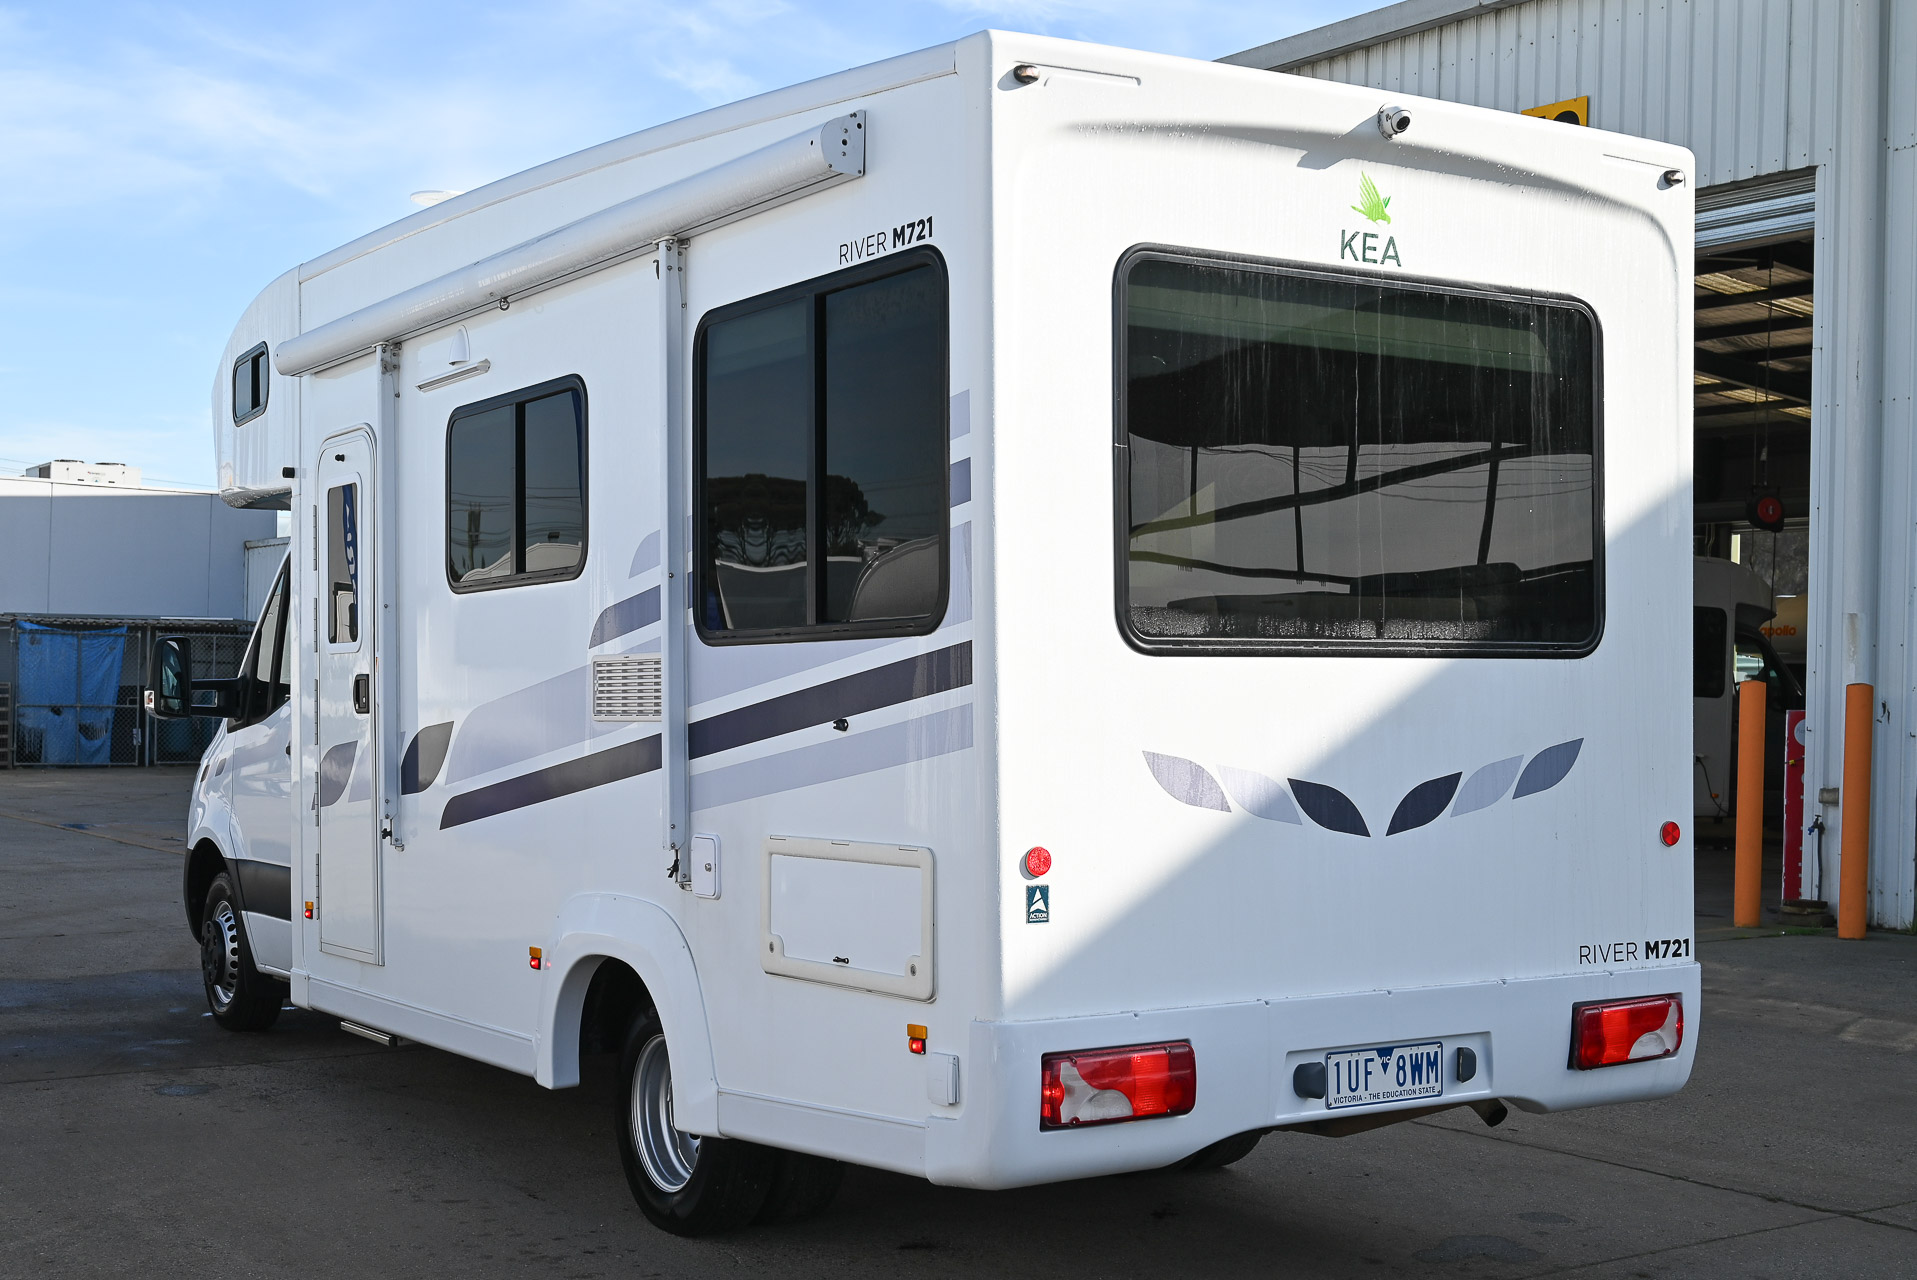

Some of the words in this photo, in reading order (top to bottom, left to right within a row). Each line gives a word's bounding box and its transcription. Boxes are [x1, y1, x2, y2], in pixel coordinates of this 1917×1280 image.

[839, 231, 887, 265] RIVER
[892, 215, 933, 249] M721
[1340, 229, 1402, 267] KEA
[1759, 624, 1797, 639] apollo
[1579, 942, 1638, 964] RIVER
[1645, 938, 1690, 960] M721
[1334, 1057, 1375, 1095] 1UF
[1396, 1050, 1439, 1088] 8WM
[1333, 1094, 1363, 1105] VICTORIA
[1368, 1092, 1381, 1100] THE
[1382, 1088, 1417, 1099] EDUCATION
[1418, 1085, 1436, 1094] STATE
